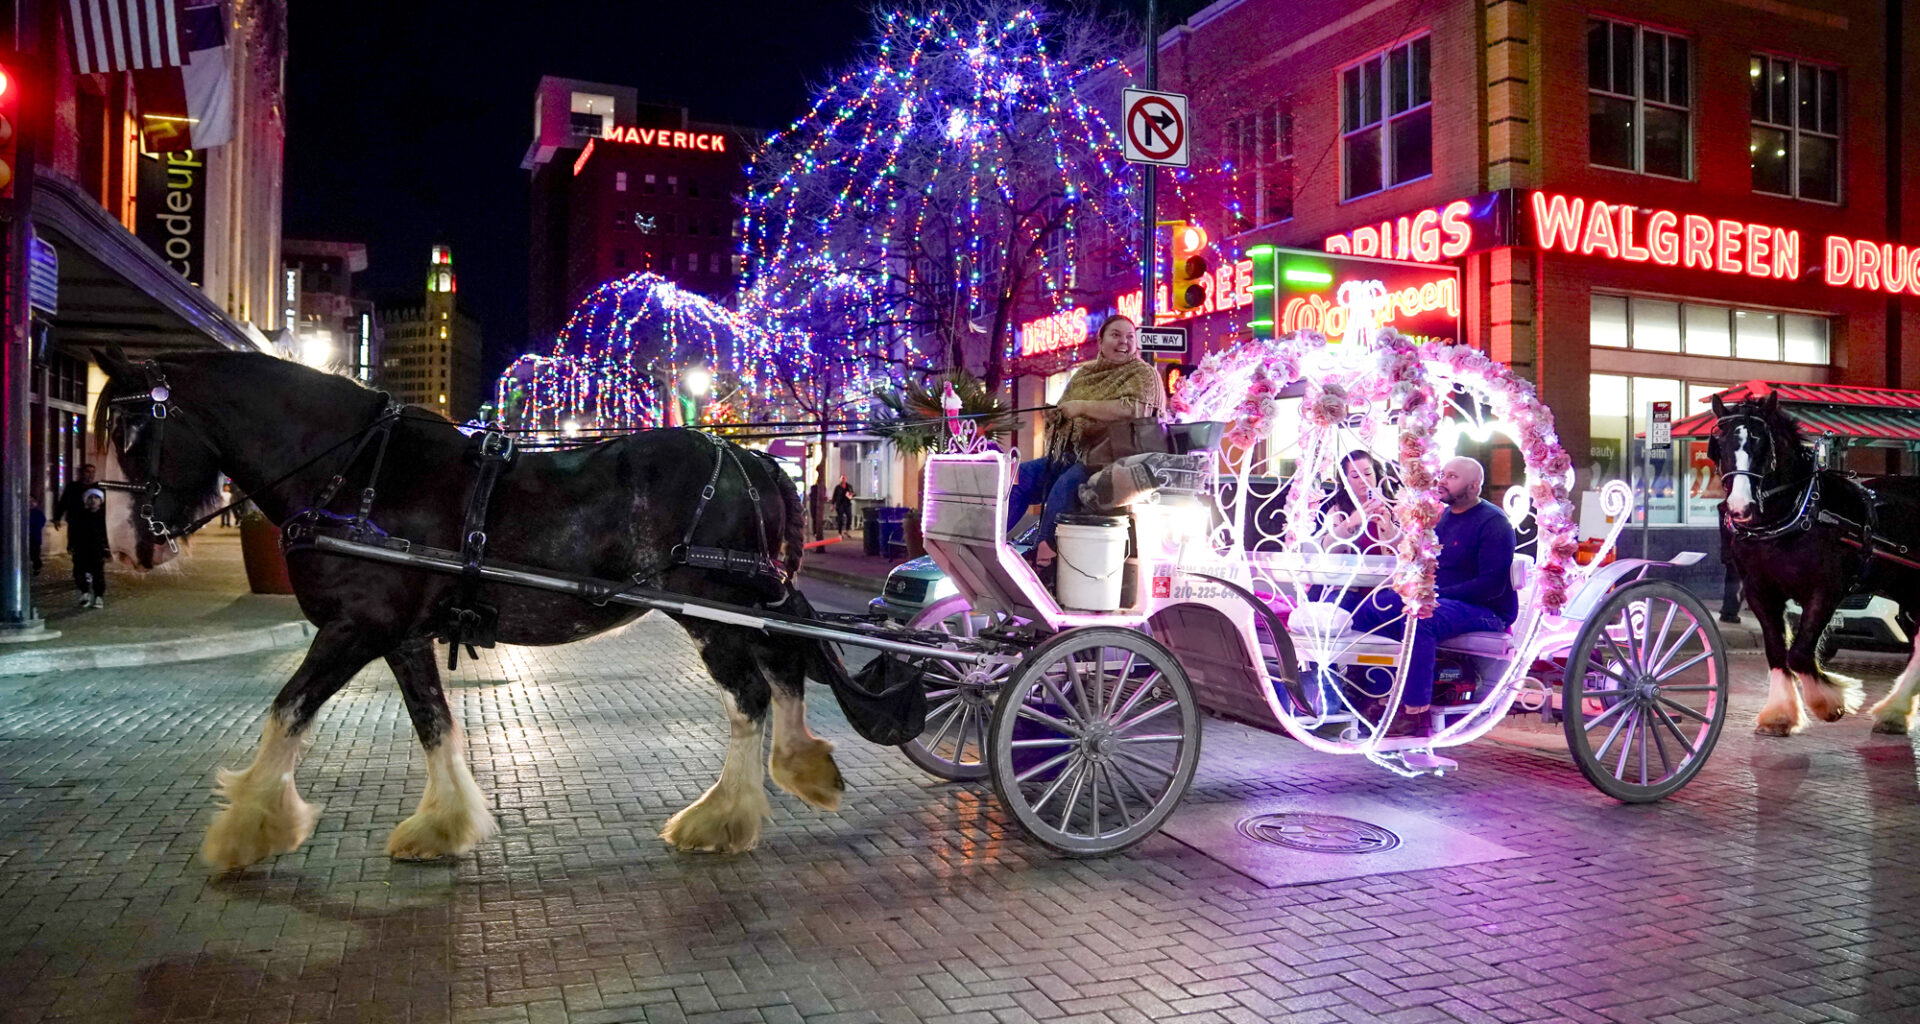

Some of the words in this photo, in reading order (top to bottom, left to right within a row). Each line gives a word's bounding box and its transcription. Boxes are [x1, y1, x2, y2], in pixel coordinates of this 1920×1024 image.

[603, 126, 726, 152] MAVERICK
[1532, 191, 1799, 280] WALGREEN
[1022, 306, 1089, 356] DRUGS
[1140, 334, 1158, 344] ONE
[1161, 335, 1179, 345] WAY
[1173, 584, 1240, 600] 210-225-64
